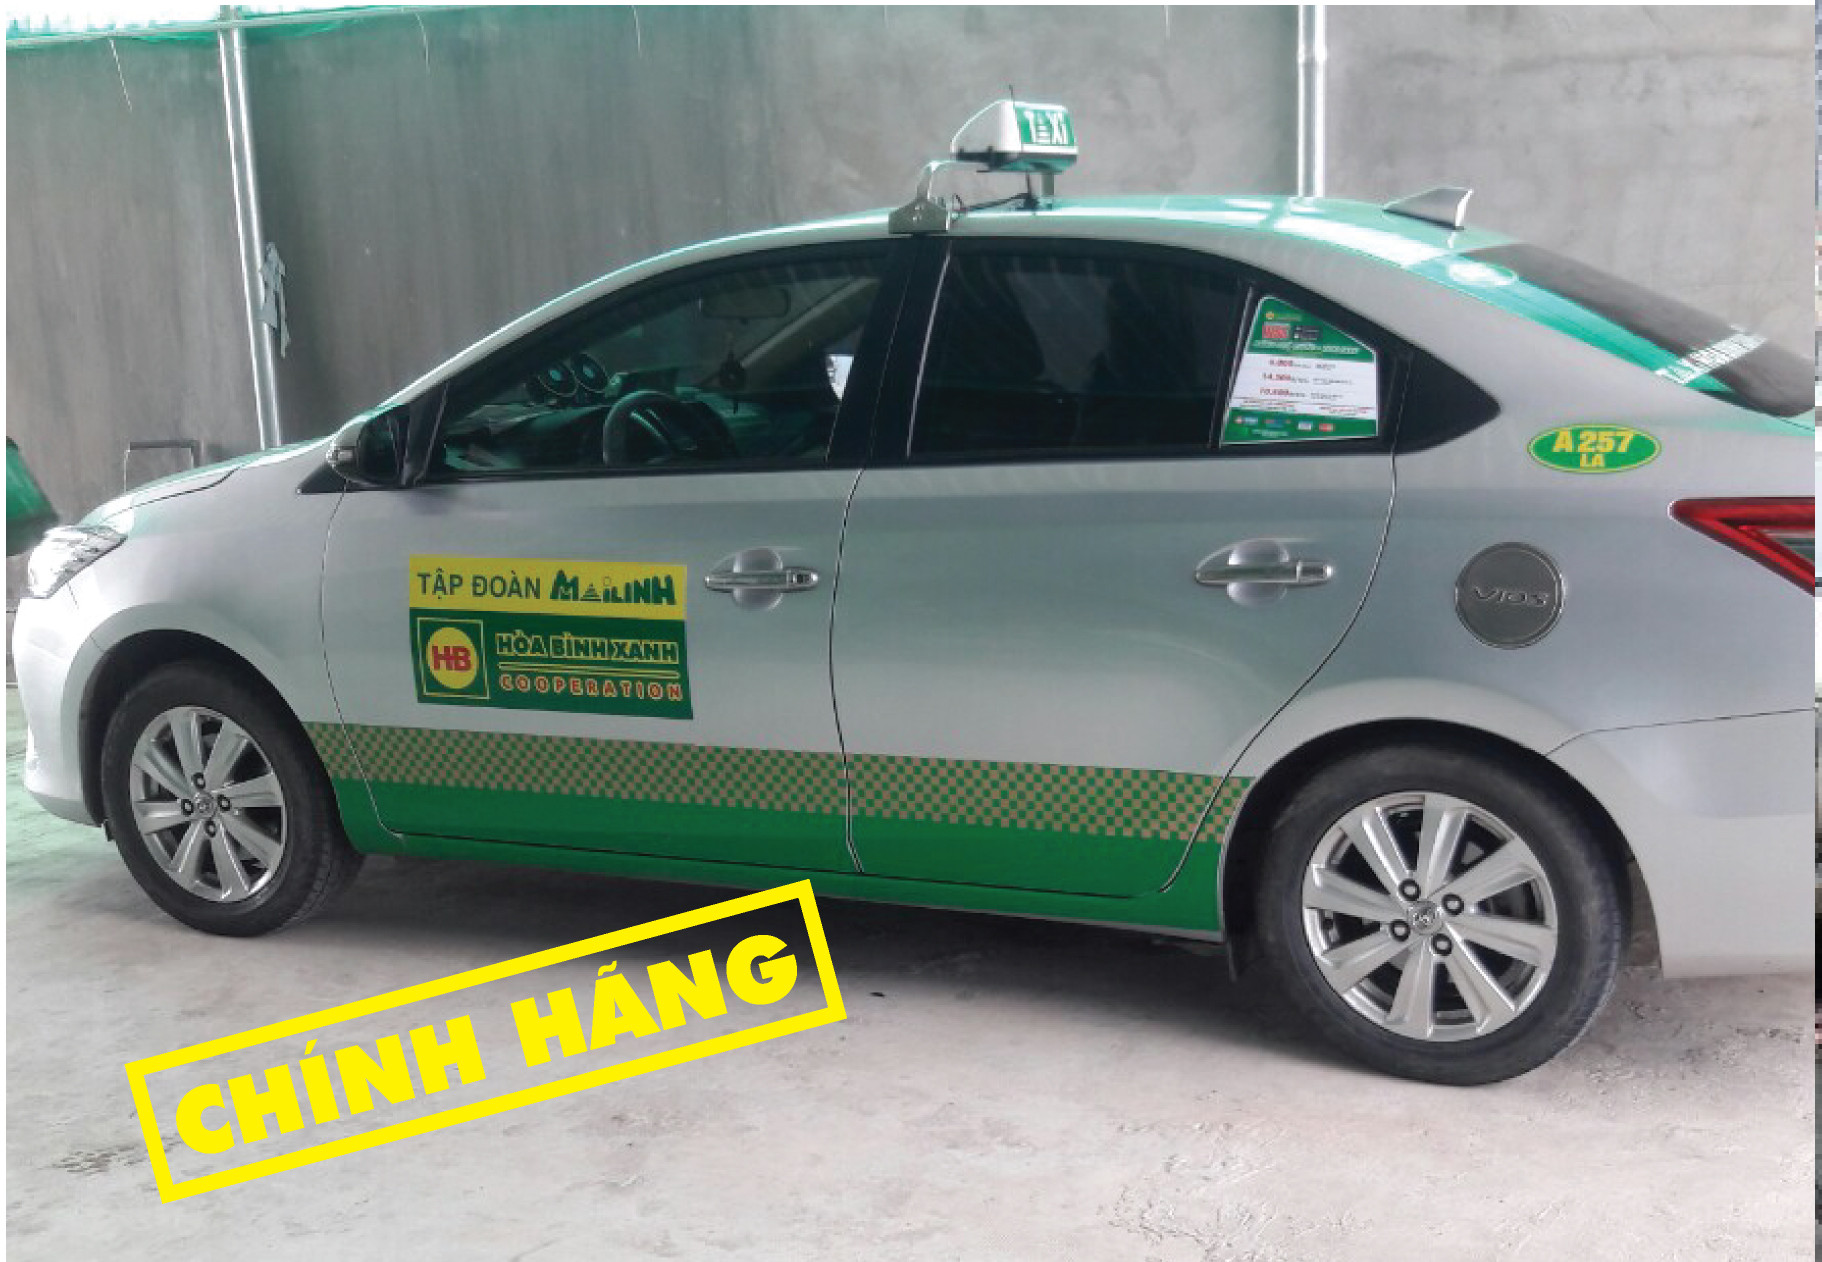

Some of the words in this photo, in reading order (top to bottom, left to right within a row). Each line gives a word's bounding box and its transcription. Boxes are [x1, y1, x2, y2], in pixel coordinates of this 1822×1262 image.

[1577, 430, 1634, 453] 257
[417, 568, 463, 600] TẬP
[471, 569, 541, 600] ĐOÀN
[431, 644, 472, 672] HB
[609, 638, 680, 664] XANH
[500, 673, 684, 702] COOPERATION
